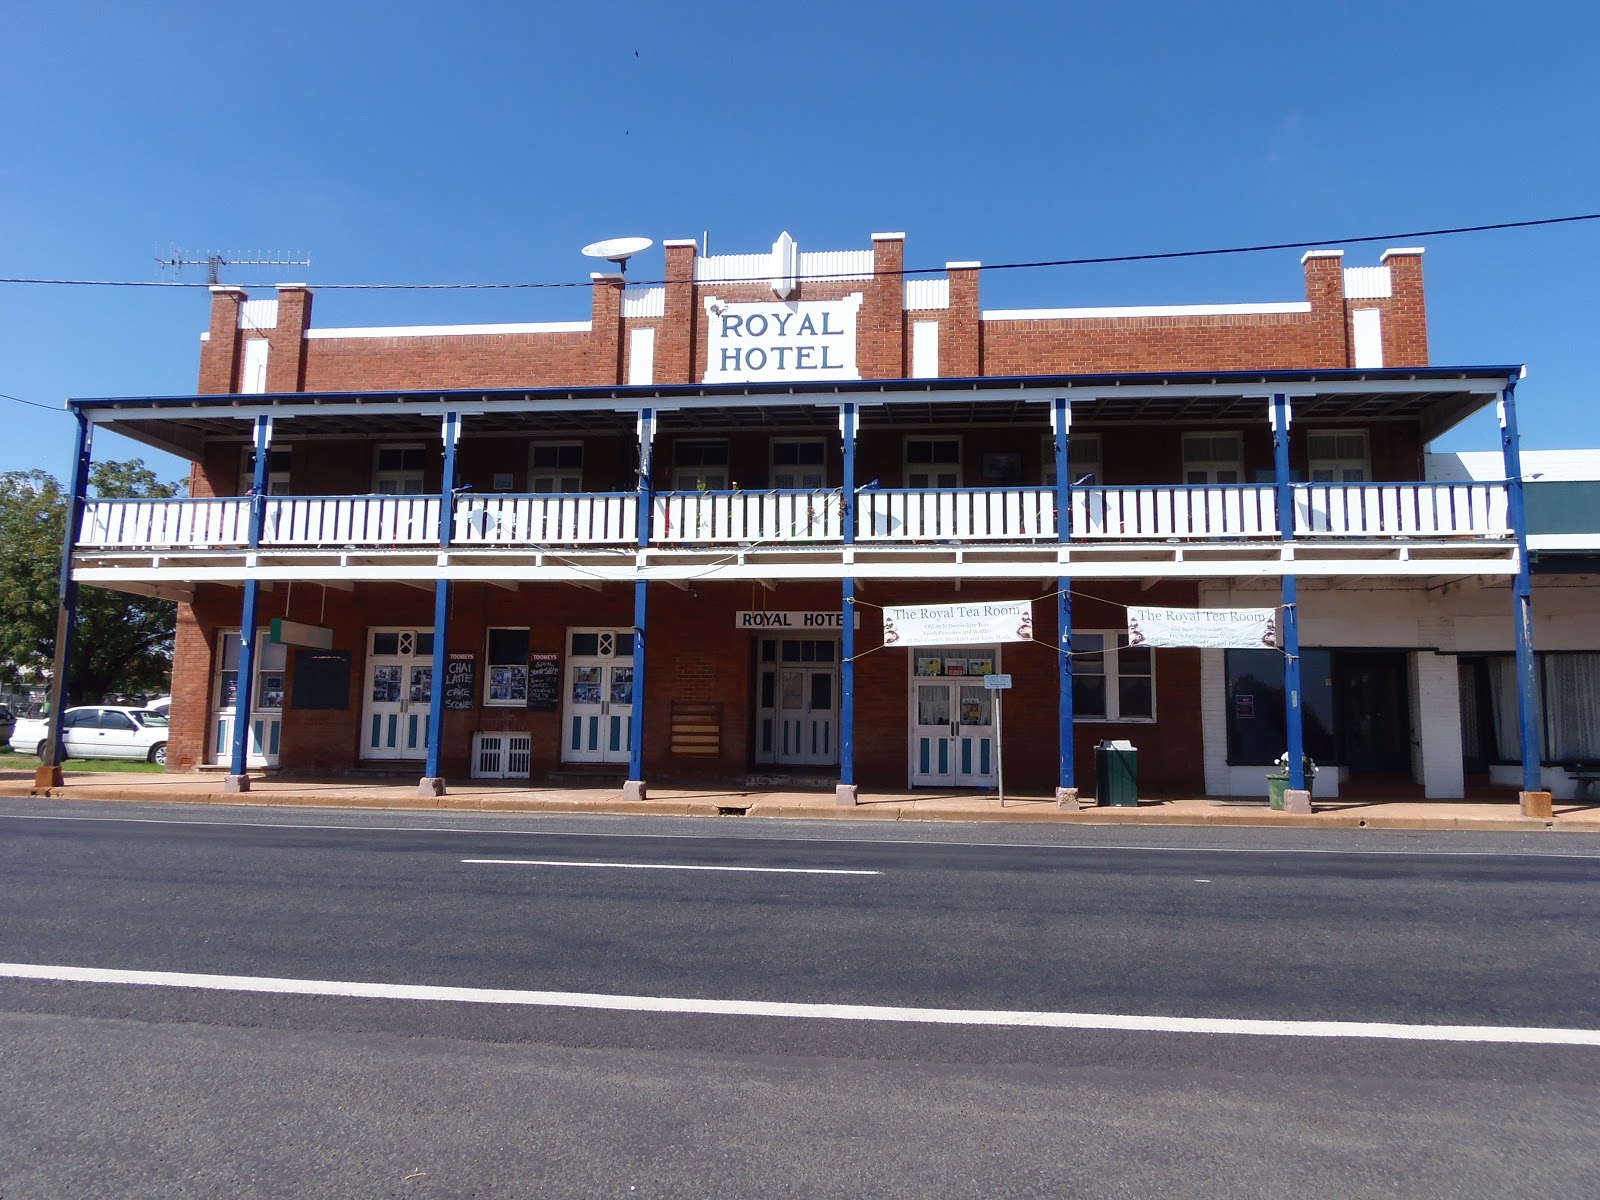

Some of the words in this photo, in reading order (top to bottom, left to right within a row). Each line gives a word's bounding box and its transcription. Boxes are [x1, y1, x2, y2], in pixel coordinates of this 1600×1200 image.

[720, 312, 844, 337] ROYAL
[719, 346, 844, 371] HOTEL
[742, 613, 792, 627] ROYAL
[803, 613, 843, 627] HOTE
[893, 608, 917, 620] The
[920, 606, 954, 621] Royal
[957, 606, 980, 618] Tea
[983, 605, 1020, 616] Room
[1138, 609, 1162, 621] The
[1166, 610, 1201, 624] Royal
[1203, 611, 1226, 622] Tea
[1230, 611, 1265, 622] Room
[446, 673, 473, 685] LATTE
[446, 687, 471, 697] CAKE
[445, 699, 474, 709] SCONES
